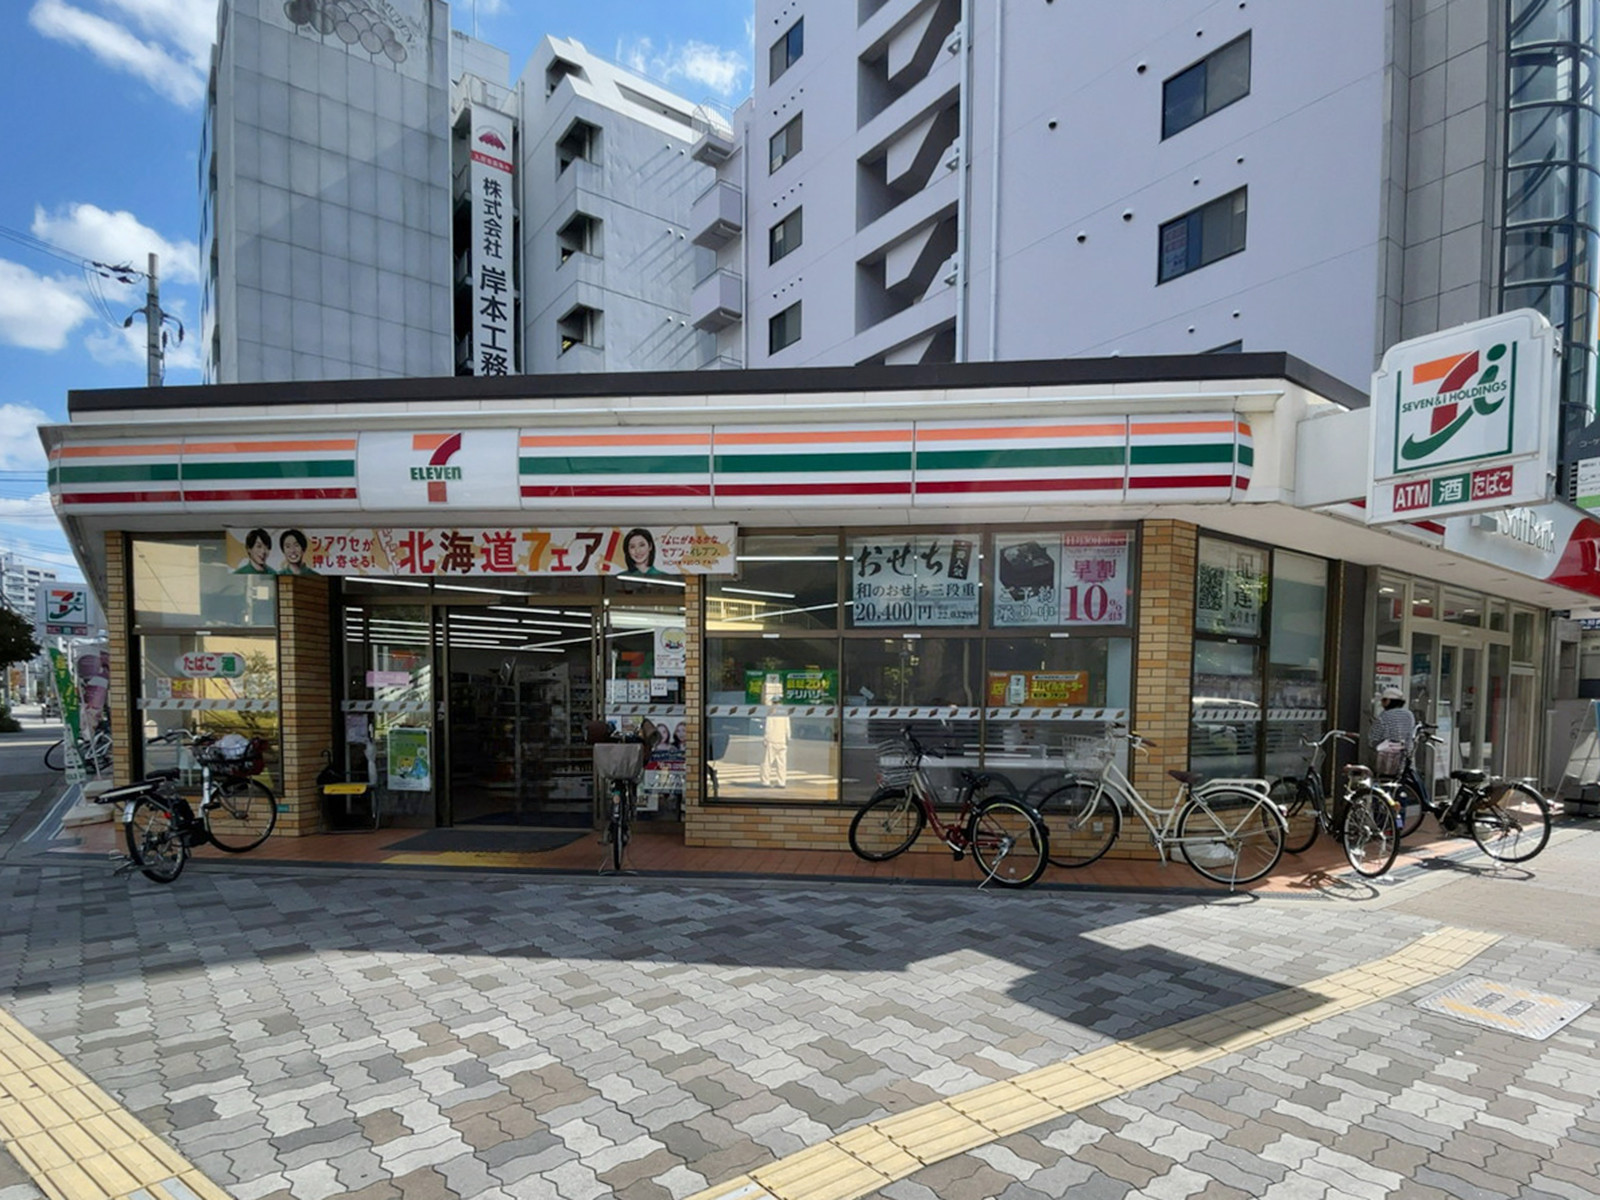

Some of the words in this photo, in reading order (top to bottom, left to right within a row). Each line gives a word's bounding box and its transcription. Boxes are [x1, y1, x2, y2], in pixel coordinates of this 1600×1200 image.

[1448, 380, 1507, 402] HOLDINGS
[1439, 478, 1463, 503] 酒
[1473, 471, 1512, 497] たばこ
[1395, 483, 1429, 510] ATM
[311, 536, 374, 552] シアワセが
[857, 542, 943, 577] おせち
[856, 582, 976, 599] 和のおせち三段重
[183, 656, 216, 671] たばこ
